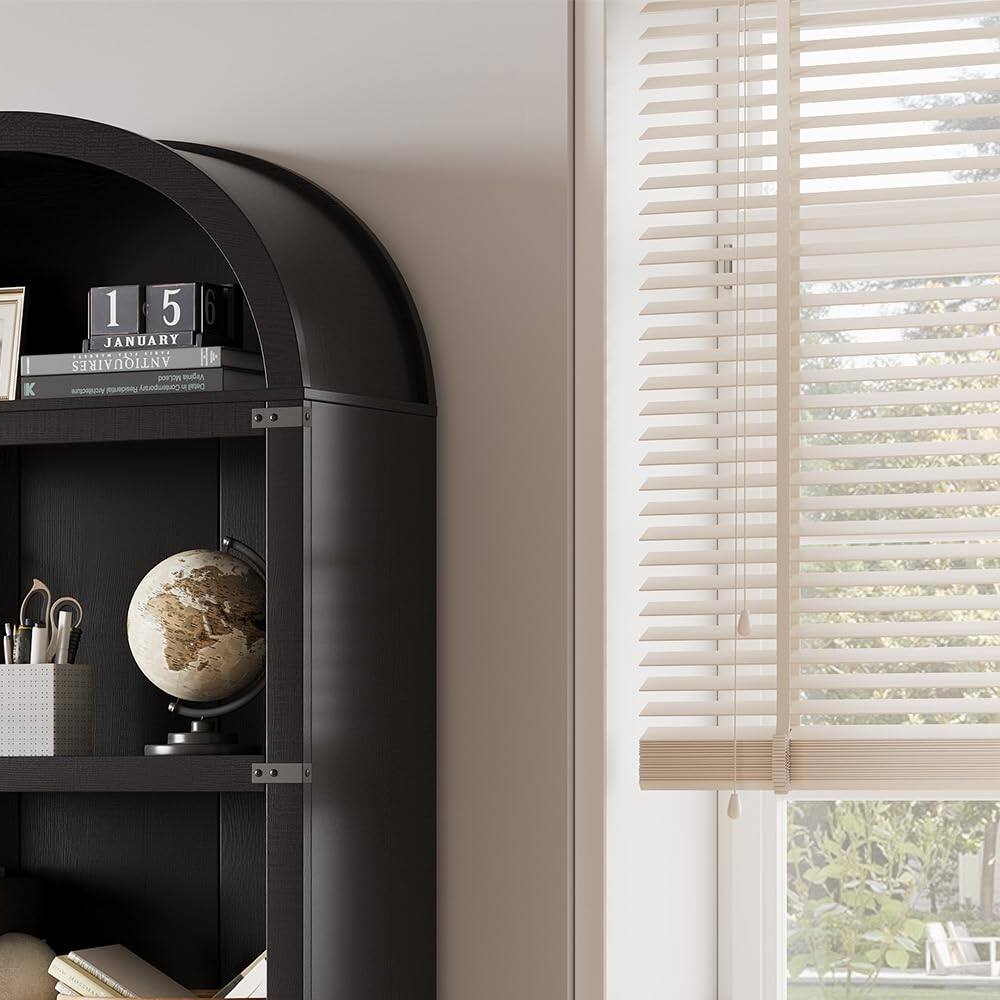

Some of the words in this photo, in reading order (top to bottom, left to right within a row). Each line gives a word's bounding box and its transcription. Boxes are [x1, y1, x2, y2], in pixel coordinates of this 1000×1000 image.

[106, 290, 120, 328] 1
[162, 288, 182, 327] 5
[104, 334, 179, 348] JANUARY
[71, 357, 171, 372] ANTIQUAIRES
[158, 374, 182, 382] McLeod
[182, 372, 205, 382] Virginia
[71, 387, 106, 395] Architecture
[106, 386, 137, 394] Residential
[139, 383, 180, 393] Contemporary
[187, 383, 205, 391] Detail
